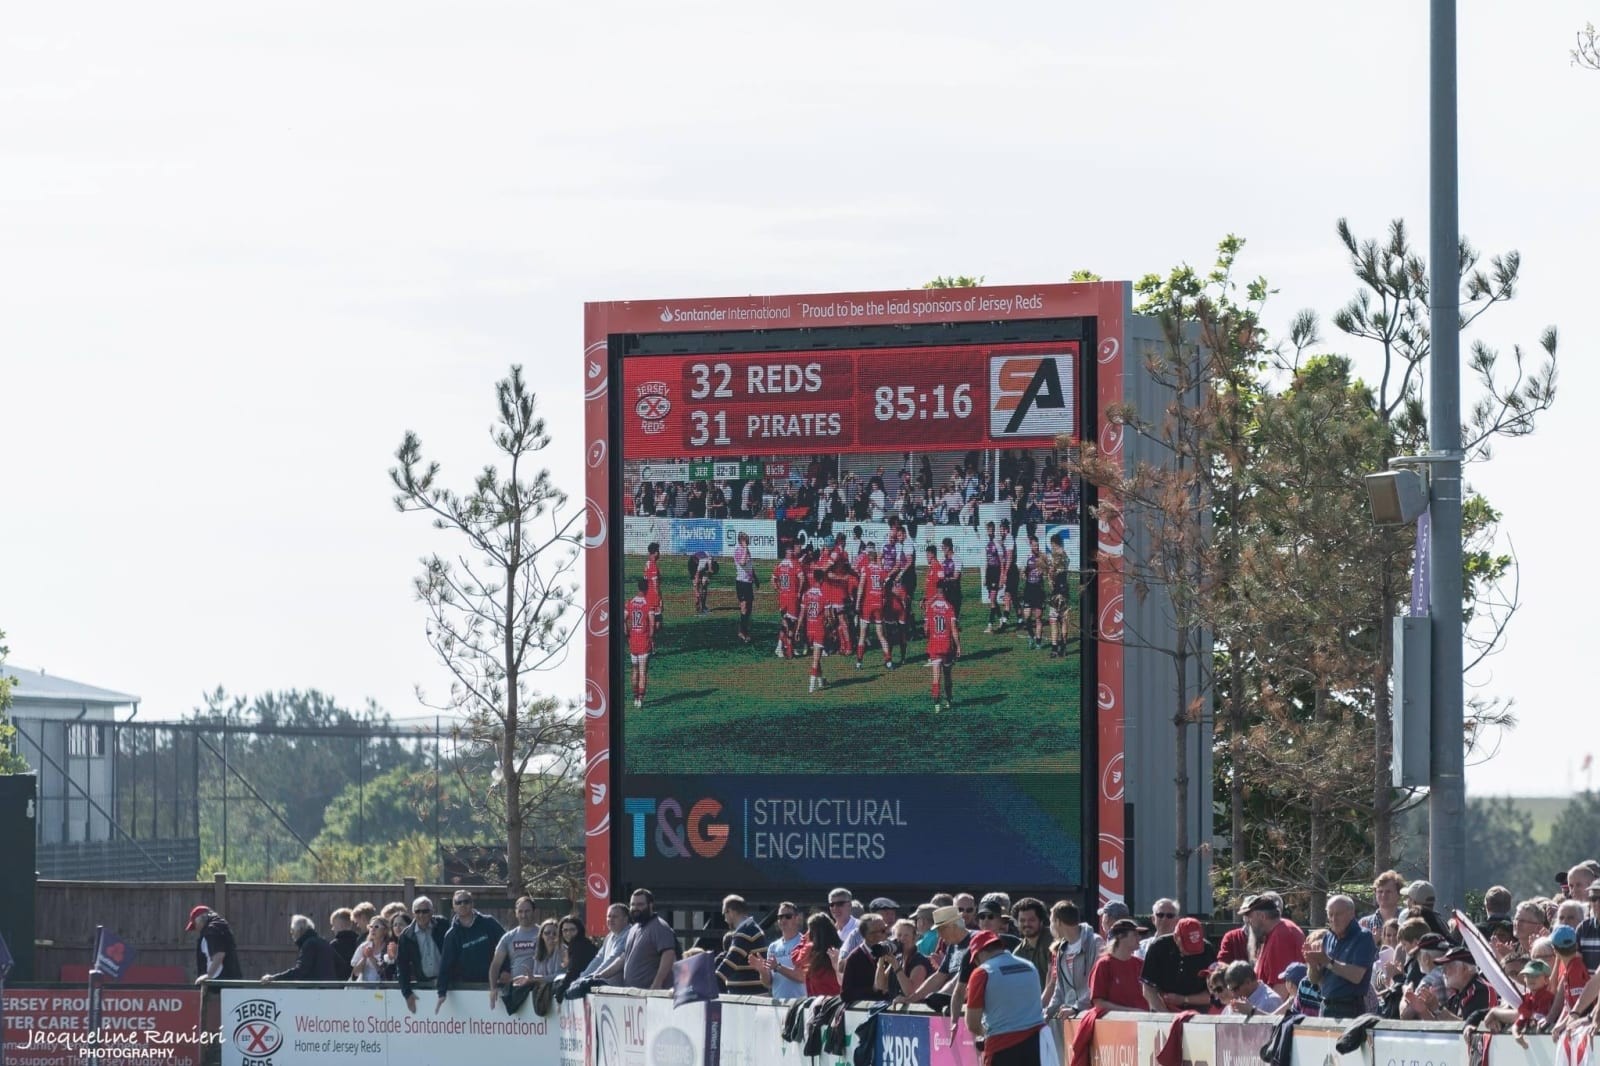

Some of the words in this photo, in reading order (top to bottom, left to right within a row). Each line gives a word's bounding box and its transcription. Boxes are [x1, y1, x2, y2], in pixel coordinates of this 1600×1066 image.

[674, 308, 726, 322] Santander
[727, 306, 791, 320] International
[802, 302, 834, 318] Proud
[836, 303, 848, 317] to
[850, 302, 864, 316] be
[866, 301, 884, 315] the
[887, 299, 910, 314] lead
[912, 301, 961, 317] sponsors
[964, 297, 977, 312] of
[977, 296, 1013, 314] Jersey
[1015, 294, 1042, 309] Reds
[691, 363, 733, 399] 32
[747, 363, 822, 394] REDS
[874, 384, 972, 420] 85:16
[690, 410, 731, 446] 31
[747, 412, 841, 438] PIRATES
[754, 799, 908, 826] STRUCTURAL
[624, 797, 730, 858] T&G
[754, 832, 886, 859] ENGINEERS
[3, 998, 48, 1011] ERSEY
[147, 998, 182, 1012] AND
[235, 1003, 281, 1022] JERSEY
[38, 1015, 79, 1030] CARE
[83, 1016, 156, 1030] SRVICES
[295, 1015, 350, 1033] Welcome
[353, 1016, 365, 1033] to
[367, 1015, 401, 1034] Stade
[404, 1016, 466, 1035] Santander
[469, 1017, 548, 1036] International
[294, 1040, 320, 1053] Home
[321, 1040, 331, 1053] of
[332, 1040, 359, 1056] Jersey
[360, 1040, 381, 1053] Reds
